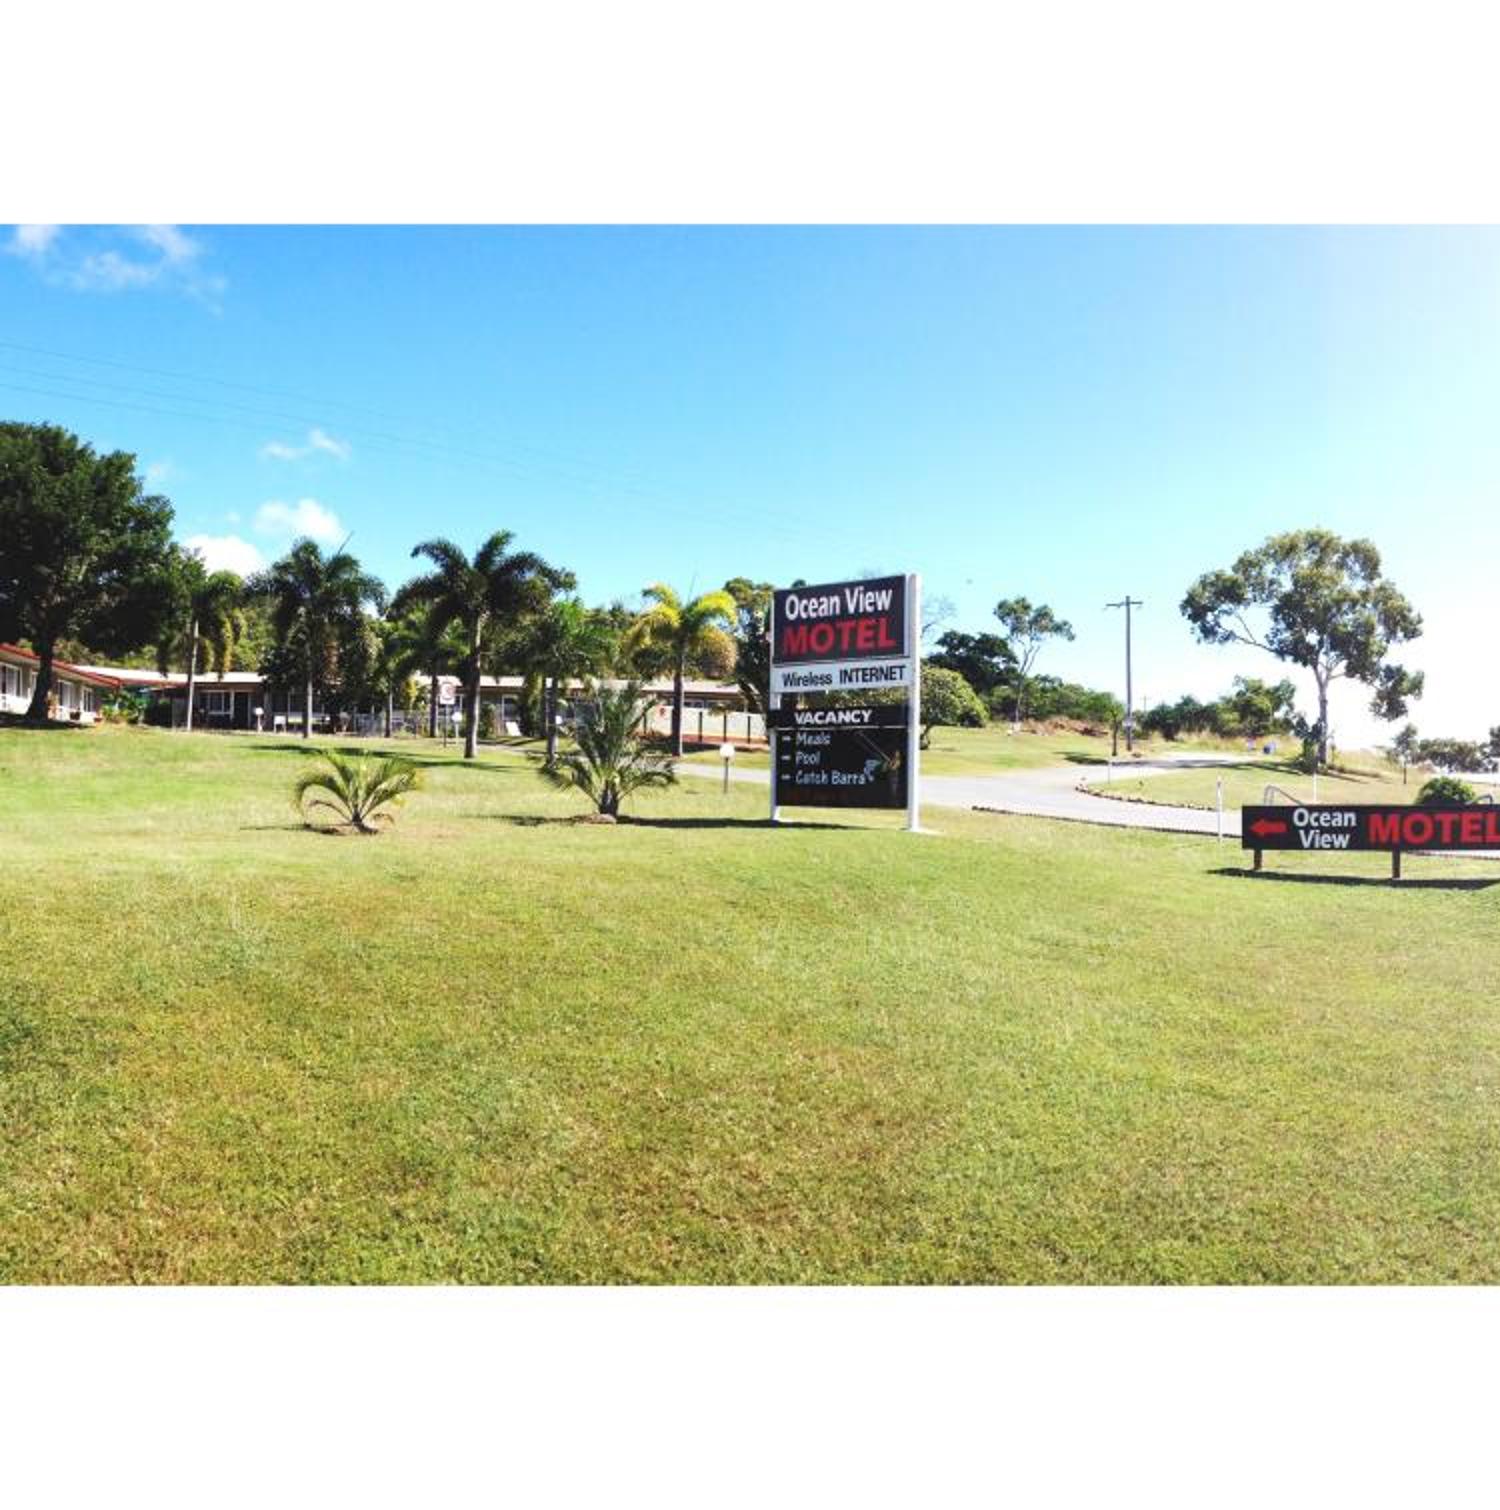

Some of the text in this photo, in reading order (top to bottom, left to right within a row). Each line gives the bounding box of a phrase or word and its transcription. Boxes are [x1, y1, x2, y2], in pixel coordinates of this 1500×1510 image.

[785, 586, 893, 620] Ocean View
[783, 617, 896, 656] MOTEL
[782, 665, 906, 687] Wireless INTERNET
[795, 709, 872, 724] VACANCY
[796, 732, 831, 745] Meals
[795, 752, 820, 765] Pool
[795, 770, 866, 785] Catch Barra
[1293, 808, 1356, 827] Ocean
[1300, 829, 1350, 848] View
